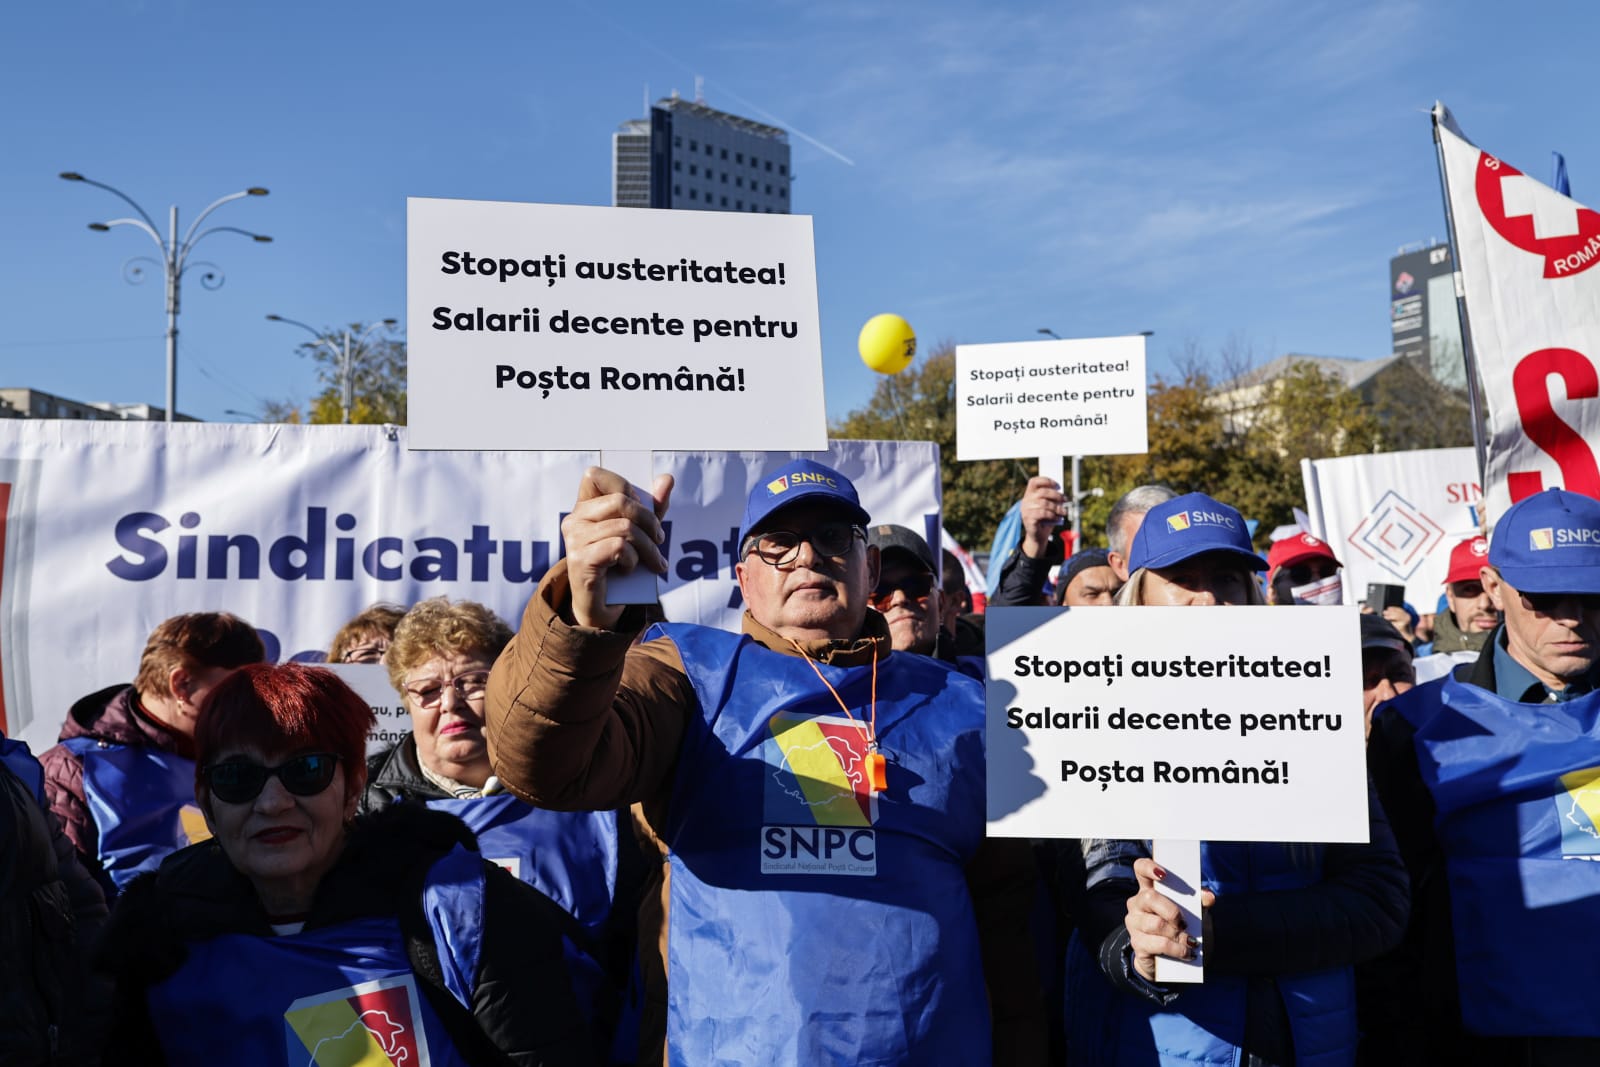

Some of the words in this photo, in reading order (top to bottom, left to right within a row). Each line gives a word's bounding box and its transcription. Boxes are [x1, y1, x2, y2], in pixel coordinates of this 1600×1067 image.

[441, 250, 566, 288] Stopați
[575, 257, 786, 286] austeritatea!
[432, 306, 540, 333] Salarii
[549, 309, 685, 336] decente
[693, 314, 798, 343] pentru
[495, 364, 591, 400] Poșta
[600, 365, 745, 392] Română!
[970, 365, 1025, 383] Stopați
[1028, 359, 1129, 377] austeritatea!
[967, 392, 1013, 407] Salarii
[1017, 389, 1079, 404] decente
[1083, 386, 1135, 403] pentru
[993, 418, 1036, 434] Poșta
[1039, 413, 1108, 429] Română!
[790, 471, 837, 489] SNPC
[1192, 511, 1235, 529] SNPC
[1556, 528, 1600, 543] SNPC
[1014, 654, 1123, 686] Stopați
[1131, 654, 1331, 678] austeritatea!
[1006, 706, 1099, 730] Salarii
[1107, 707, 1232, 731] decente
[1240, 708, 1342, 737] pentru
[1061, 760, 1144, 792] Poșta
[1153, 759, 1289, 785] Română!
[763, 827, 875, 861] SNPC
